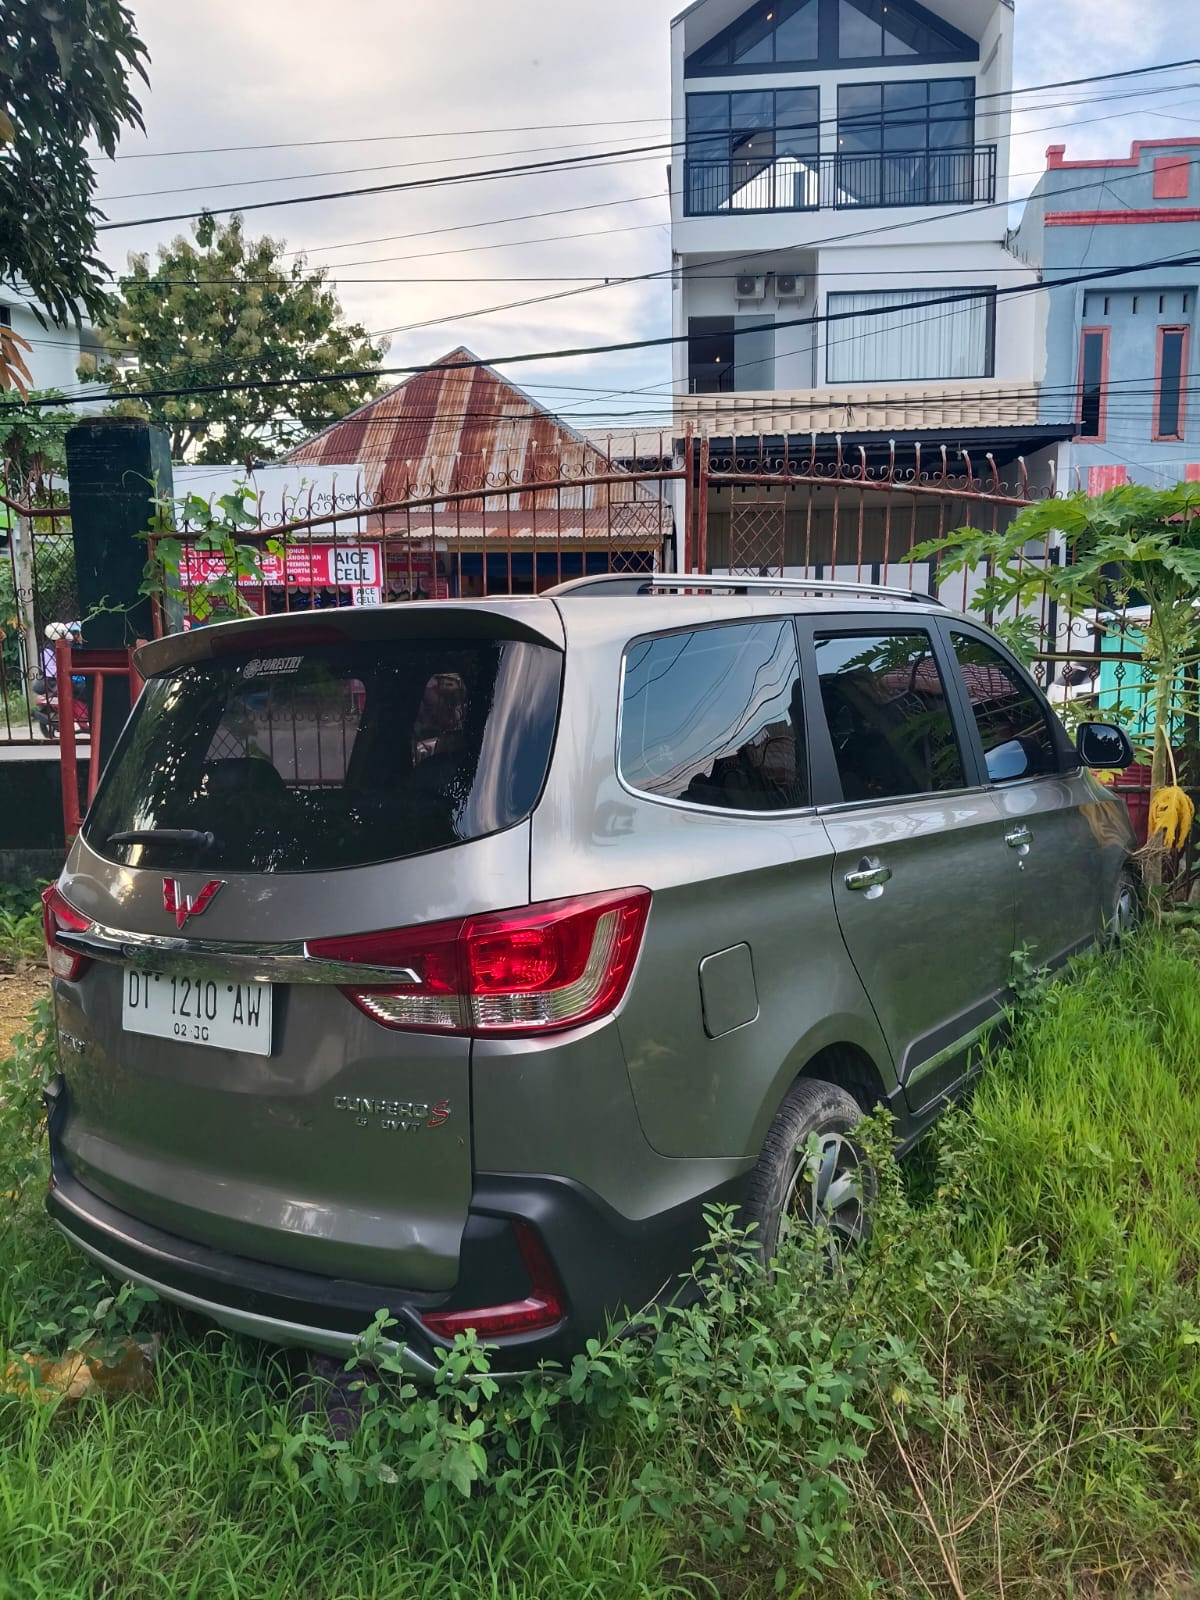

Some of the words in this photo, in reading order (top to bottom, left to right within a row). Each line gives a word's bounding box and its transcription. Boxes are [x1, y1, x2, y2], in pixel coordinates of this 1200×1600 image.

[317, 492, 336, 501] Aic
[336, 552, 369, 565] AICE
[336, 568, 371, 581] CELL
[128, 970, 152, 1009] DT
[170, 978, 217, 1021] 1210
[232, 984, 263, 1028] AW
